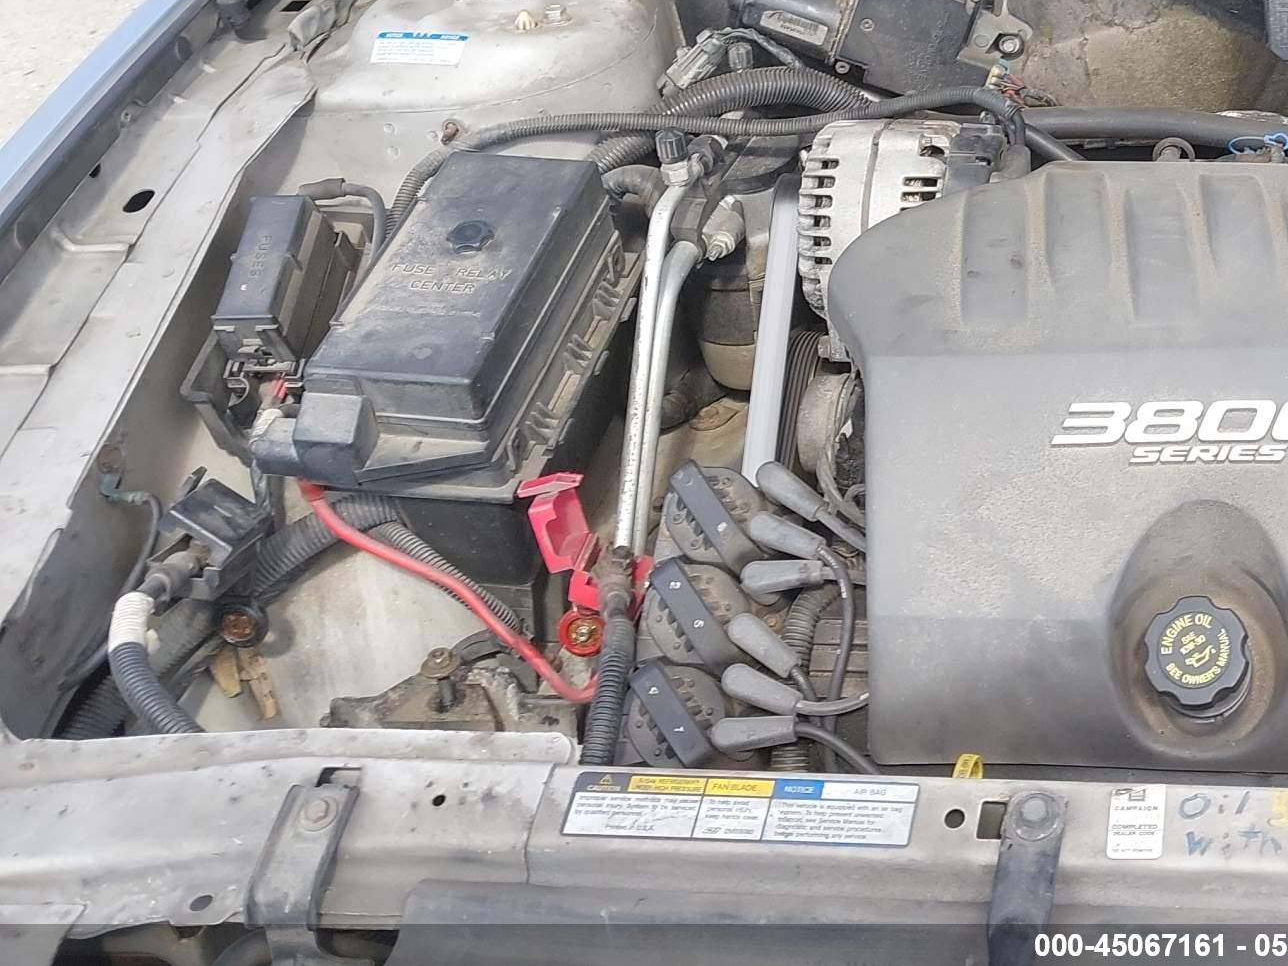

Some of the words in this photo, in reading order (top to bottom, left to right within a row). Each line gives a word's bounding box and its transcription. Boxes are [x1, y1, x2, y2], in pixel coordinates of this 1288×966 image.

[391, 263, 435, 276] FUSE
[455, 266, 513, 281] RELAY
[409, 280, 476, 294] CENTER
[1161, 614, 1194, 654] ENGINE
[1194, 613, 1213, 628] OIL
[1165, 663, 1183, 680] SEE
[1215, 628, 1231, 667] MANUAL
[783, 786, 815, 794] NOTICE
[853, 788, 867, 796] AIR
[869, 788, 886, 796] BAG
[1178, 791, 1250, 820] Oil
